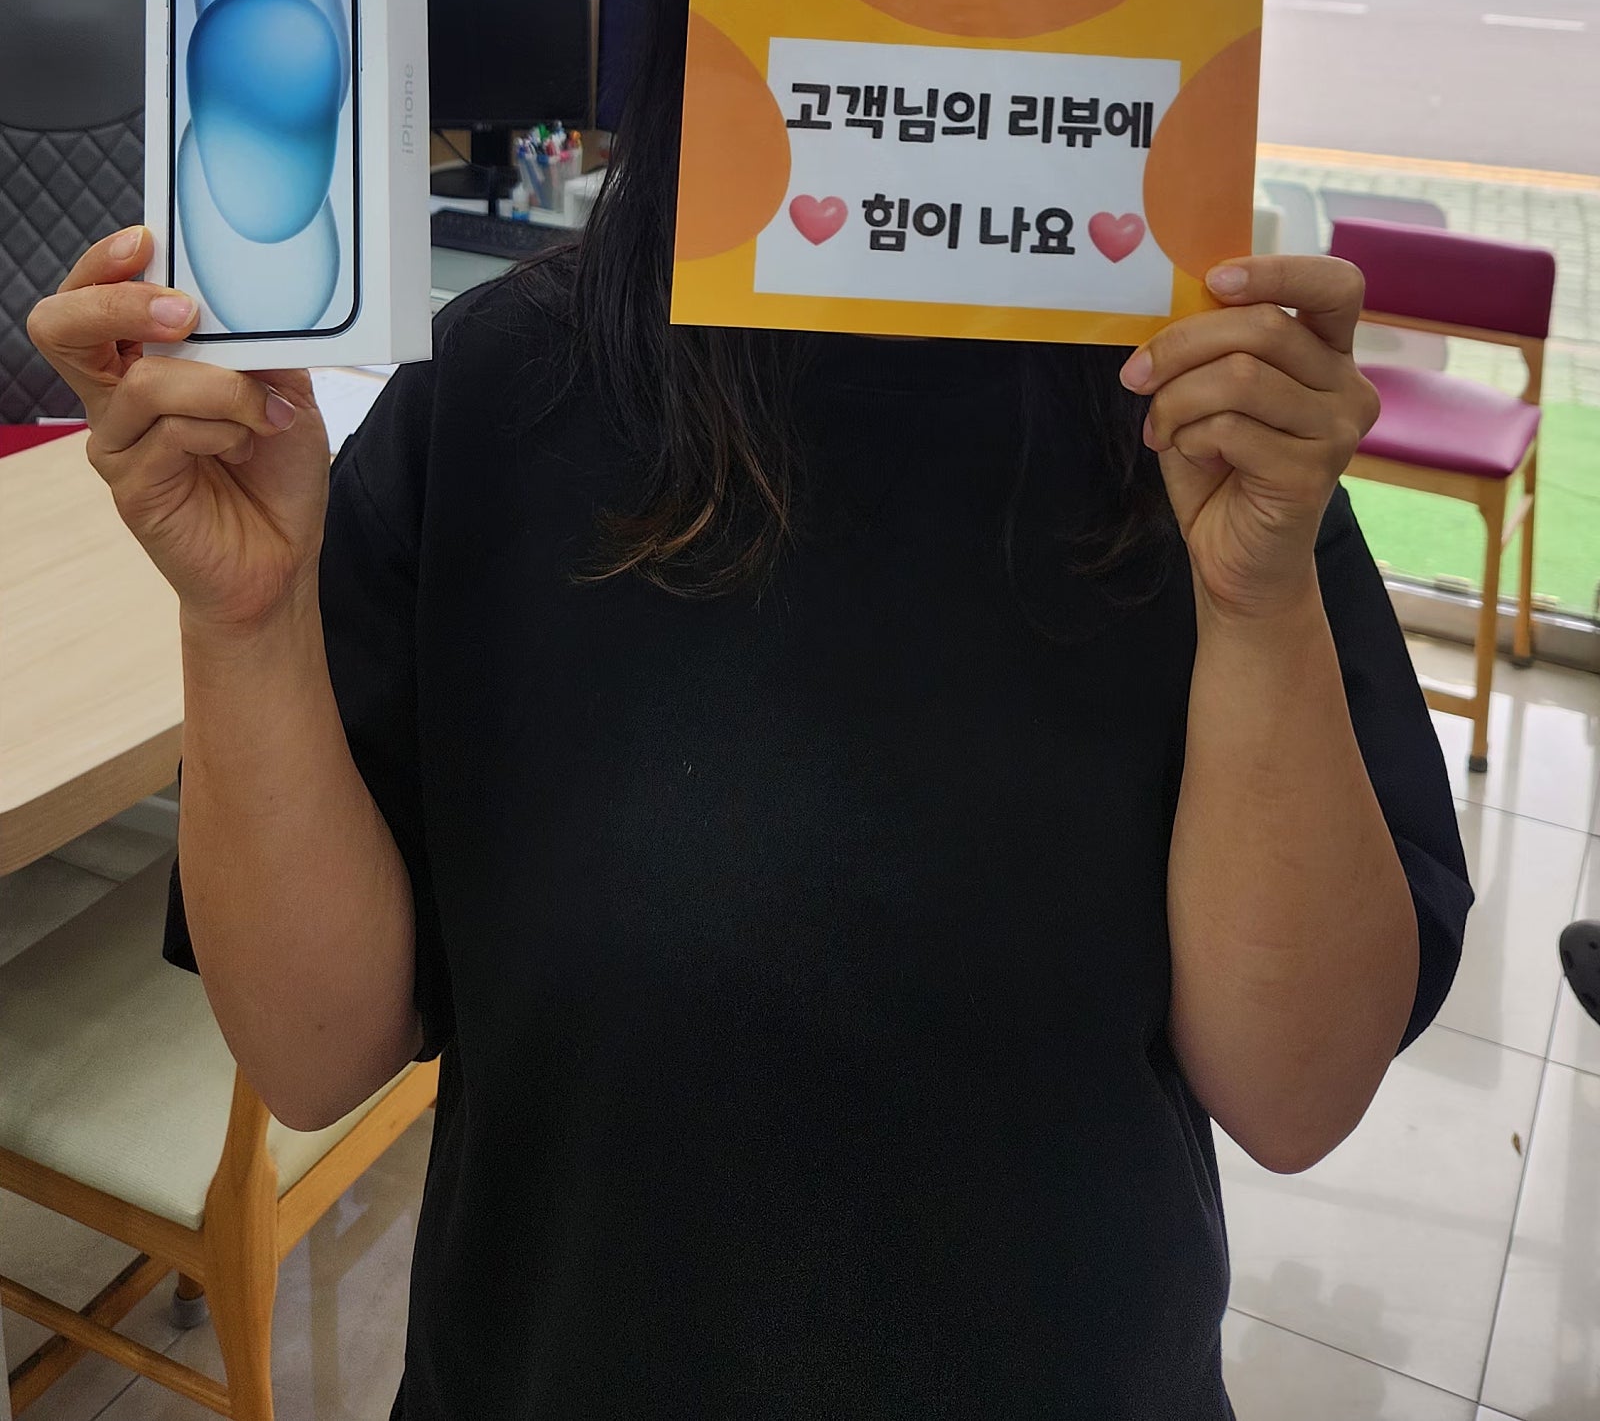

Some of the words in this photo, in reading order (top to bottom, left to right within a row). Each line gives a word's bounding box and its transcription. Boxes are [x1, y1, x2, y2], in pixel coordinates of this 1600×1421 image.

[402, 63, 415, 154] iPhone
[785, 82, 992, 143] 고객님의
[1007, 94, 1155, 149] 리뷰에
[861, 193, 963, 252] 힘이
[979, 205, 1076, 256] 나요
